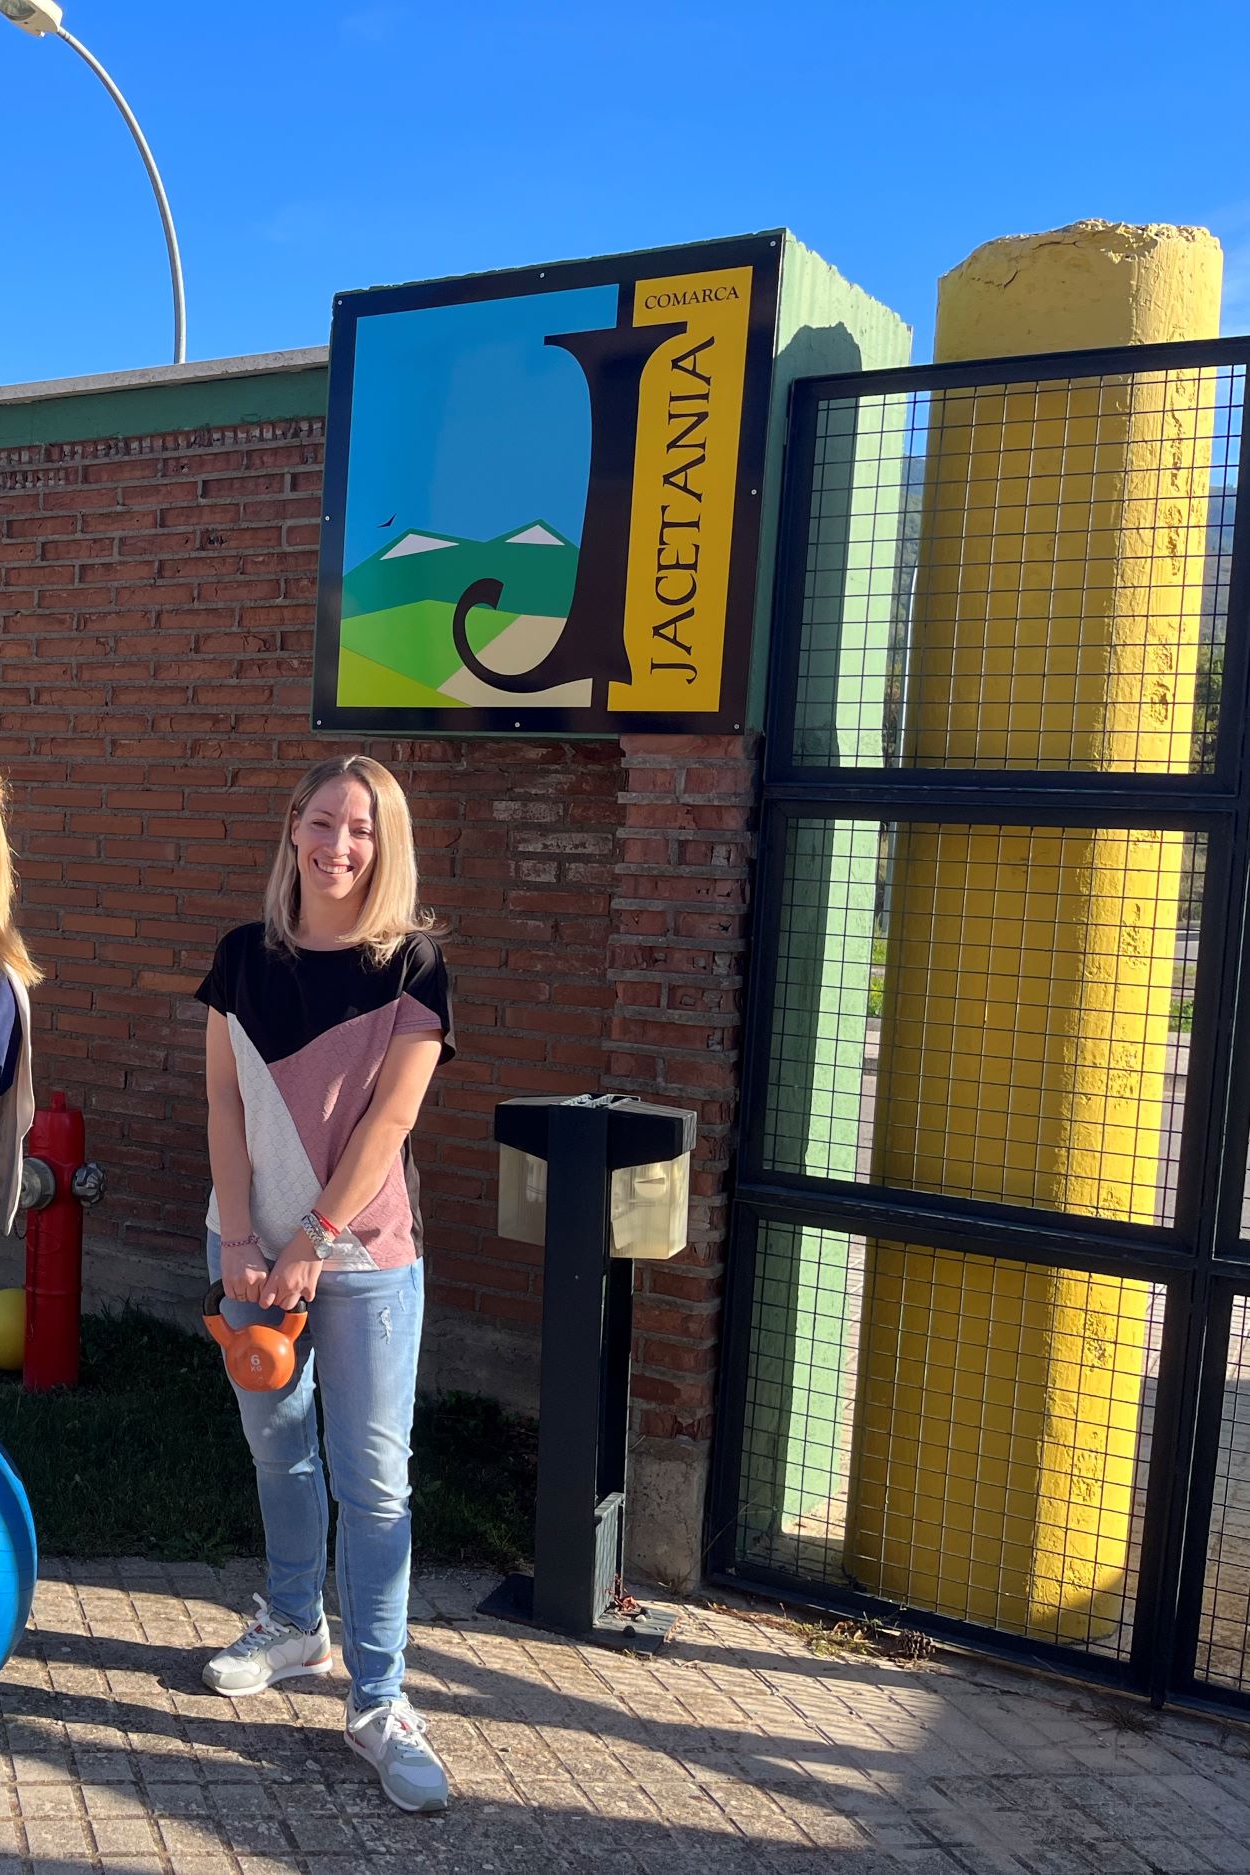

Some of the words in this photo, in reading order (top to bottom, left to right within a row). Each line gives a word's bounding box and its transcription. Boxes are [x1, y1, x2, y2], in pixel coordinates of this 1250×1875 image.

[645, 286, 739, 310] COMARCA
[650, 336, 715, 684] JACETANIA
[250, 1354, 261, 1366] 6
[250, 1365, 263, 1373] KG
